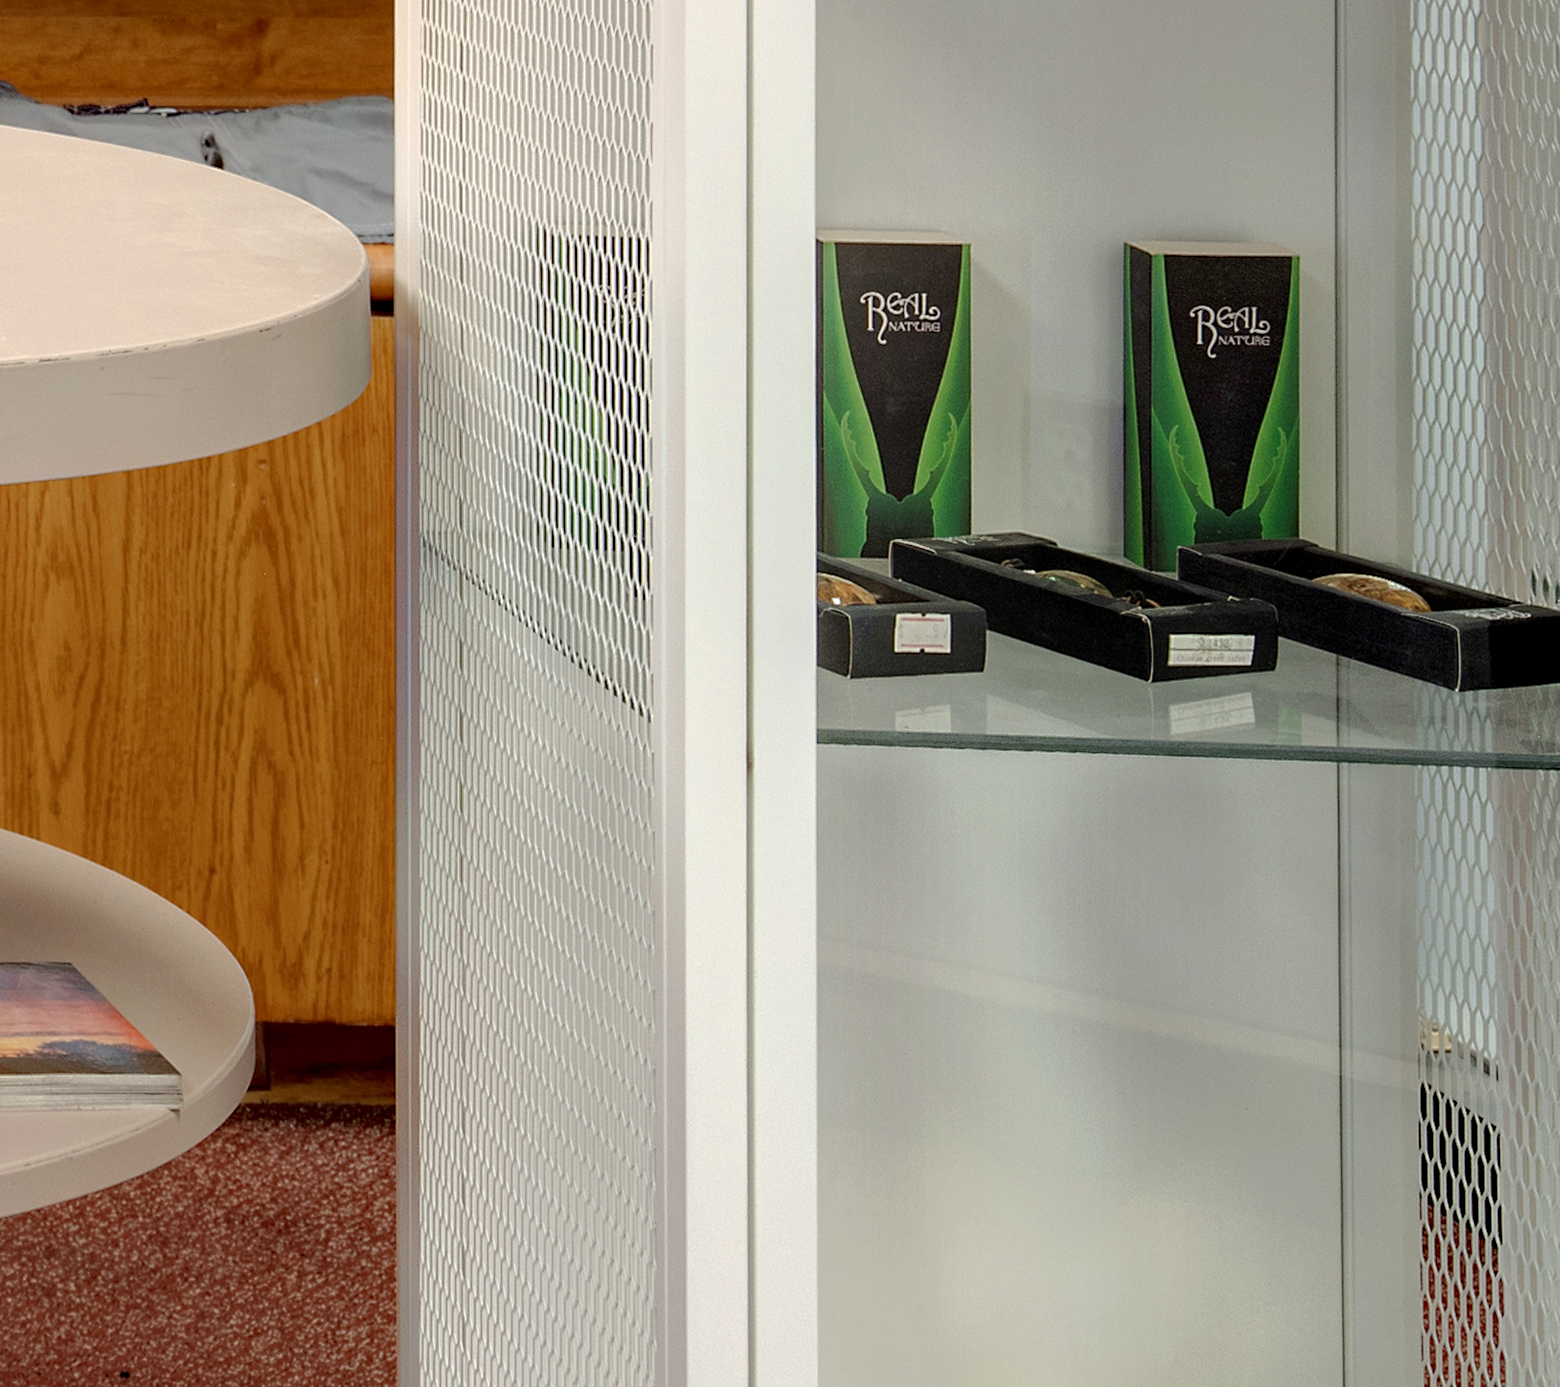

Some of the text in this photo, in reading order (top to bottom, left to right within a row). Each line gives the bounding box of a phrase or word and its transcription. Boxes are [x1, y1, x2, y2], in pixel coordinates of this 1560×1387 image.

[859, 290, 942, 344] REAL
[888, 319, 942, 333] NATURE
[1190, 305, 1271, 358] REAL
[1218, 333, 1271, 347] NATURE
